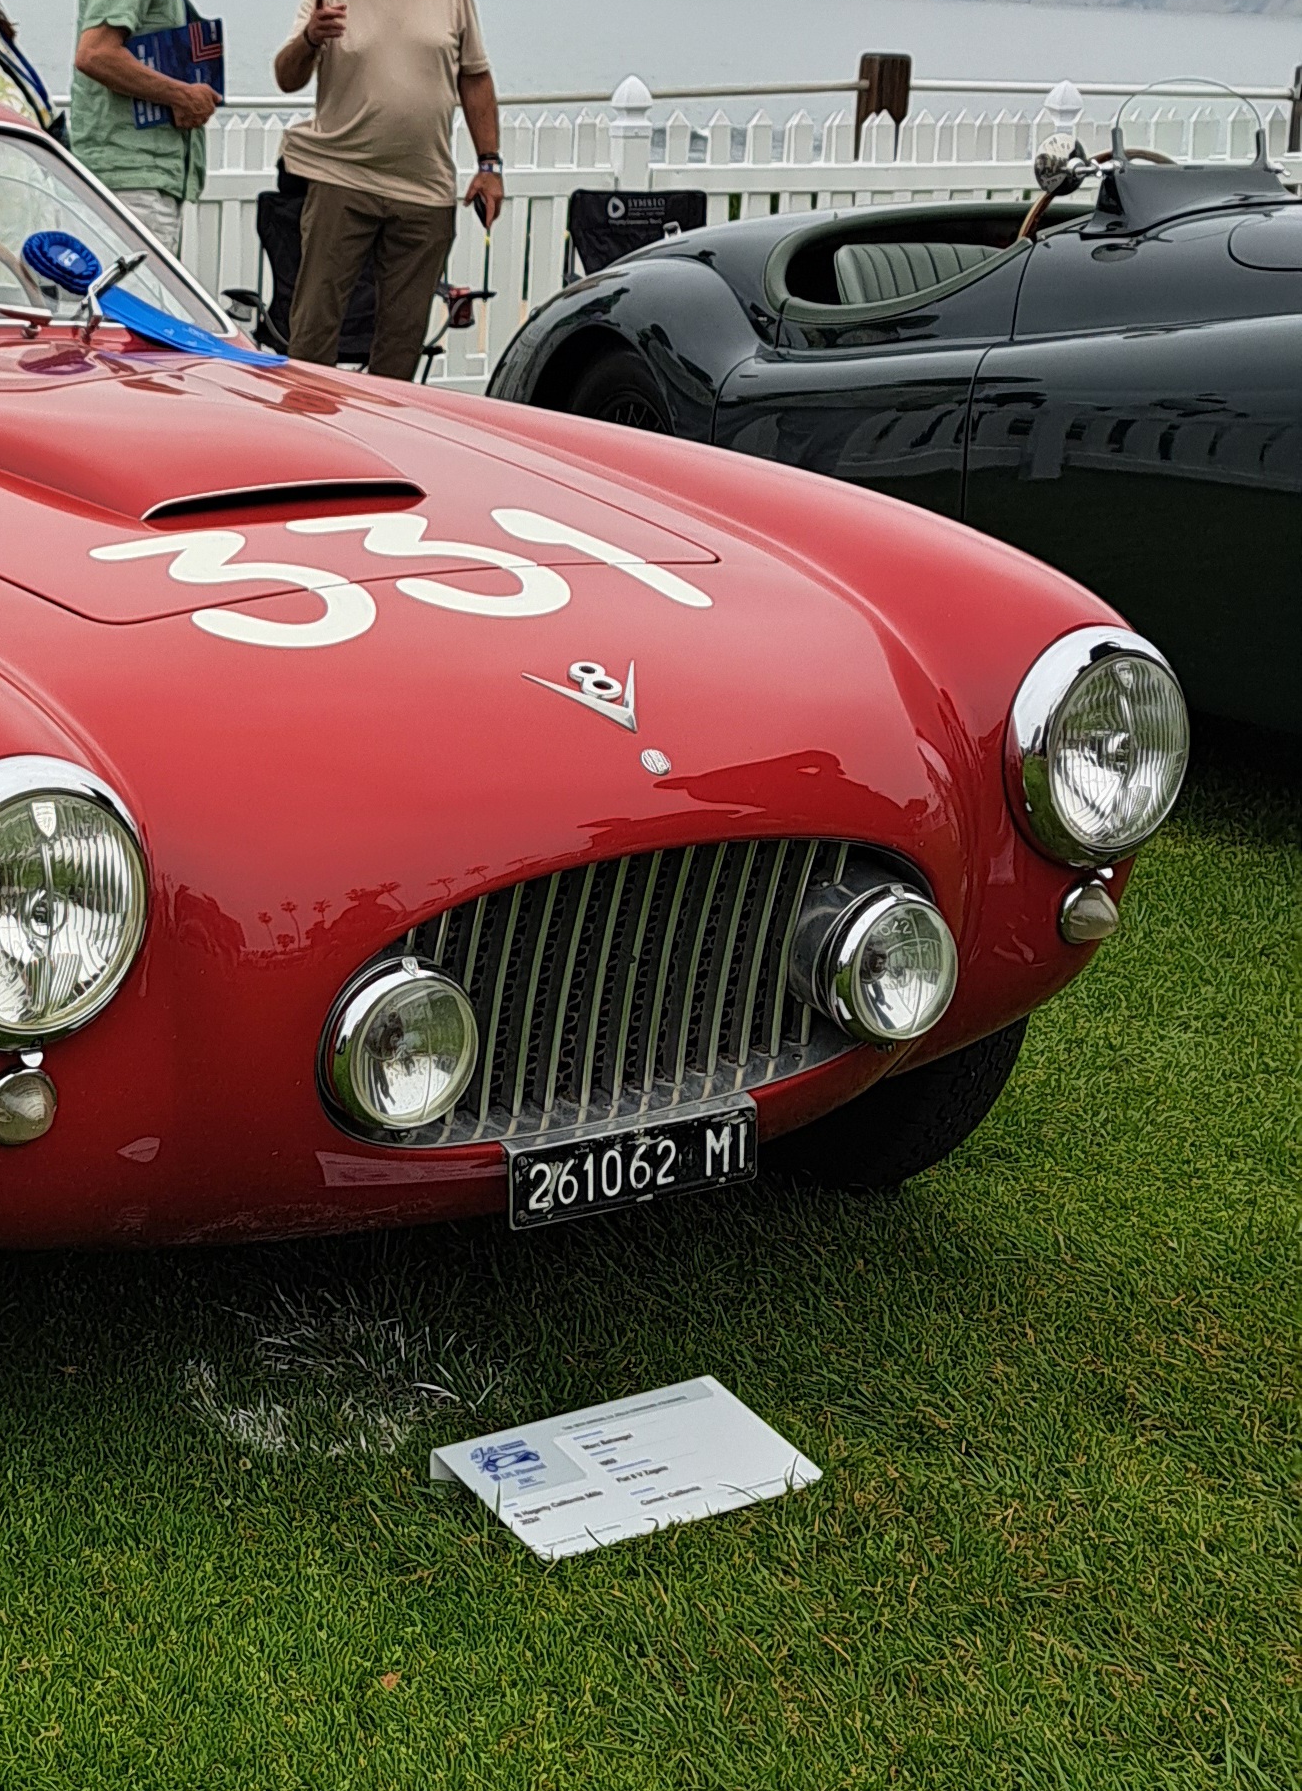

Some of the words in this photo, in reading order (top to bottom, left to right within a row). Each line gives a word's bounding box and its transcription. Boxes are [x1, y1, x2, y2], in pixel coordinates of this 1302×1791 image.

[89, 508, 713, 649] 331
[528, 1138, 677, 1212] 261062
[704, 1122, 749, 1178] MI
